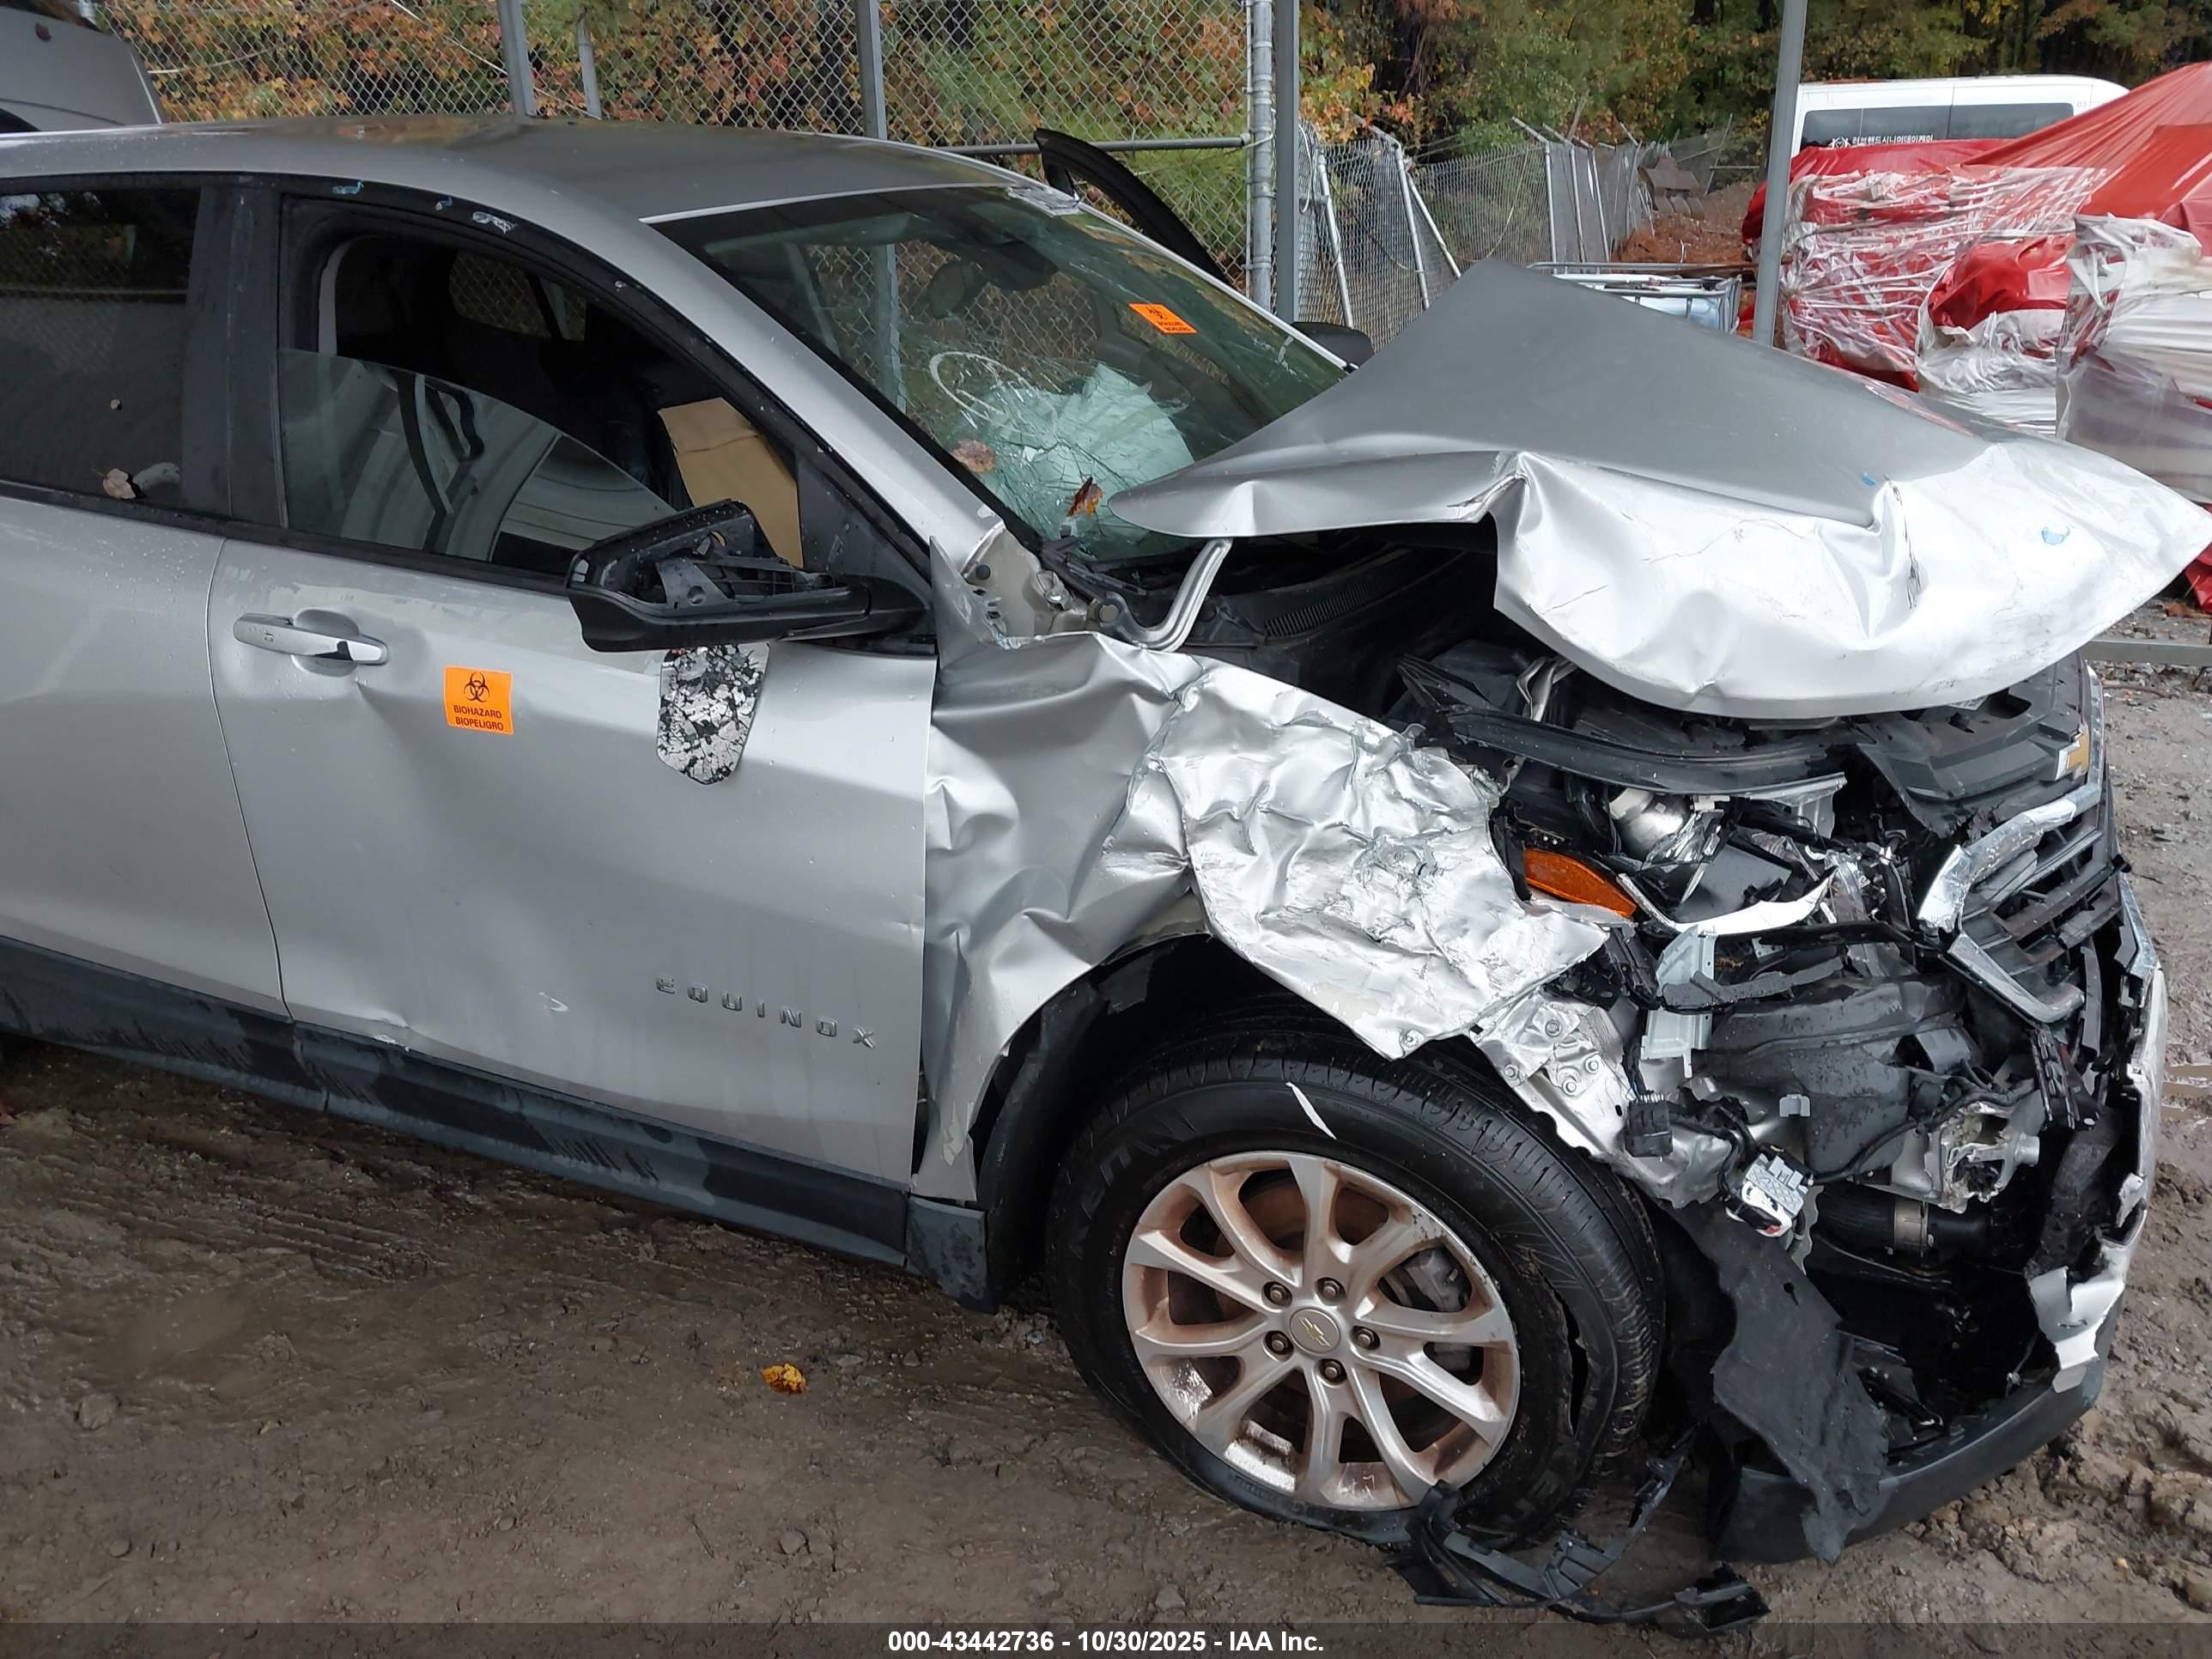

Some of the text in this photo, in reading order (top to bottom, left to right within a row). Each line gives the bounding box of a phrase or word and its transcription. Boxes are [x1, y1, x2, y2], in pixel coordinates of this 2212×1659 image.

[453, 705, 501, 719] BIOHAZARD
[455, 717, 504, 731] BIOPELIGRO
[655, 975, 875, 1048] EQUINOX
